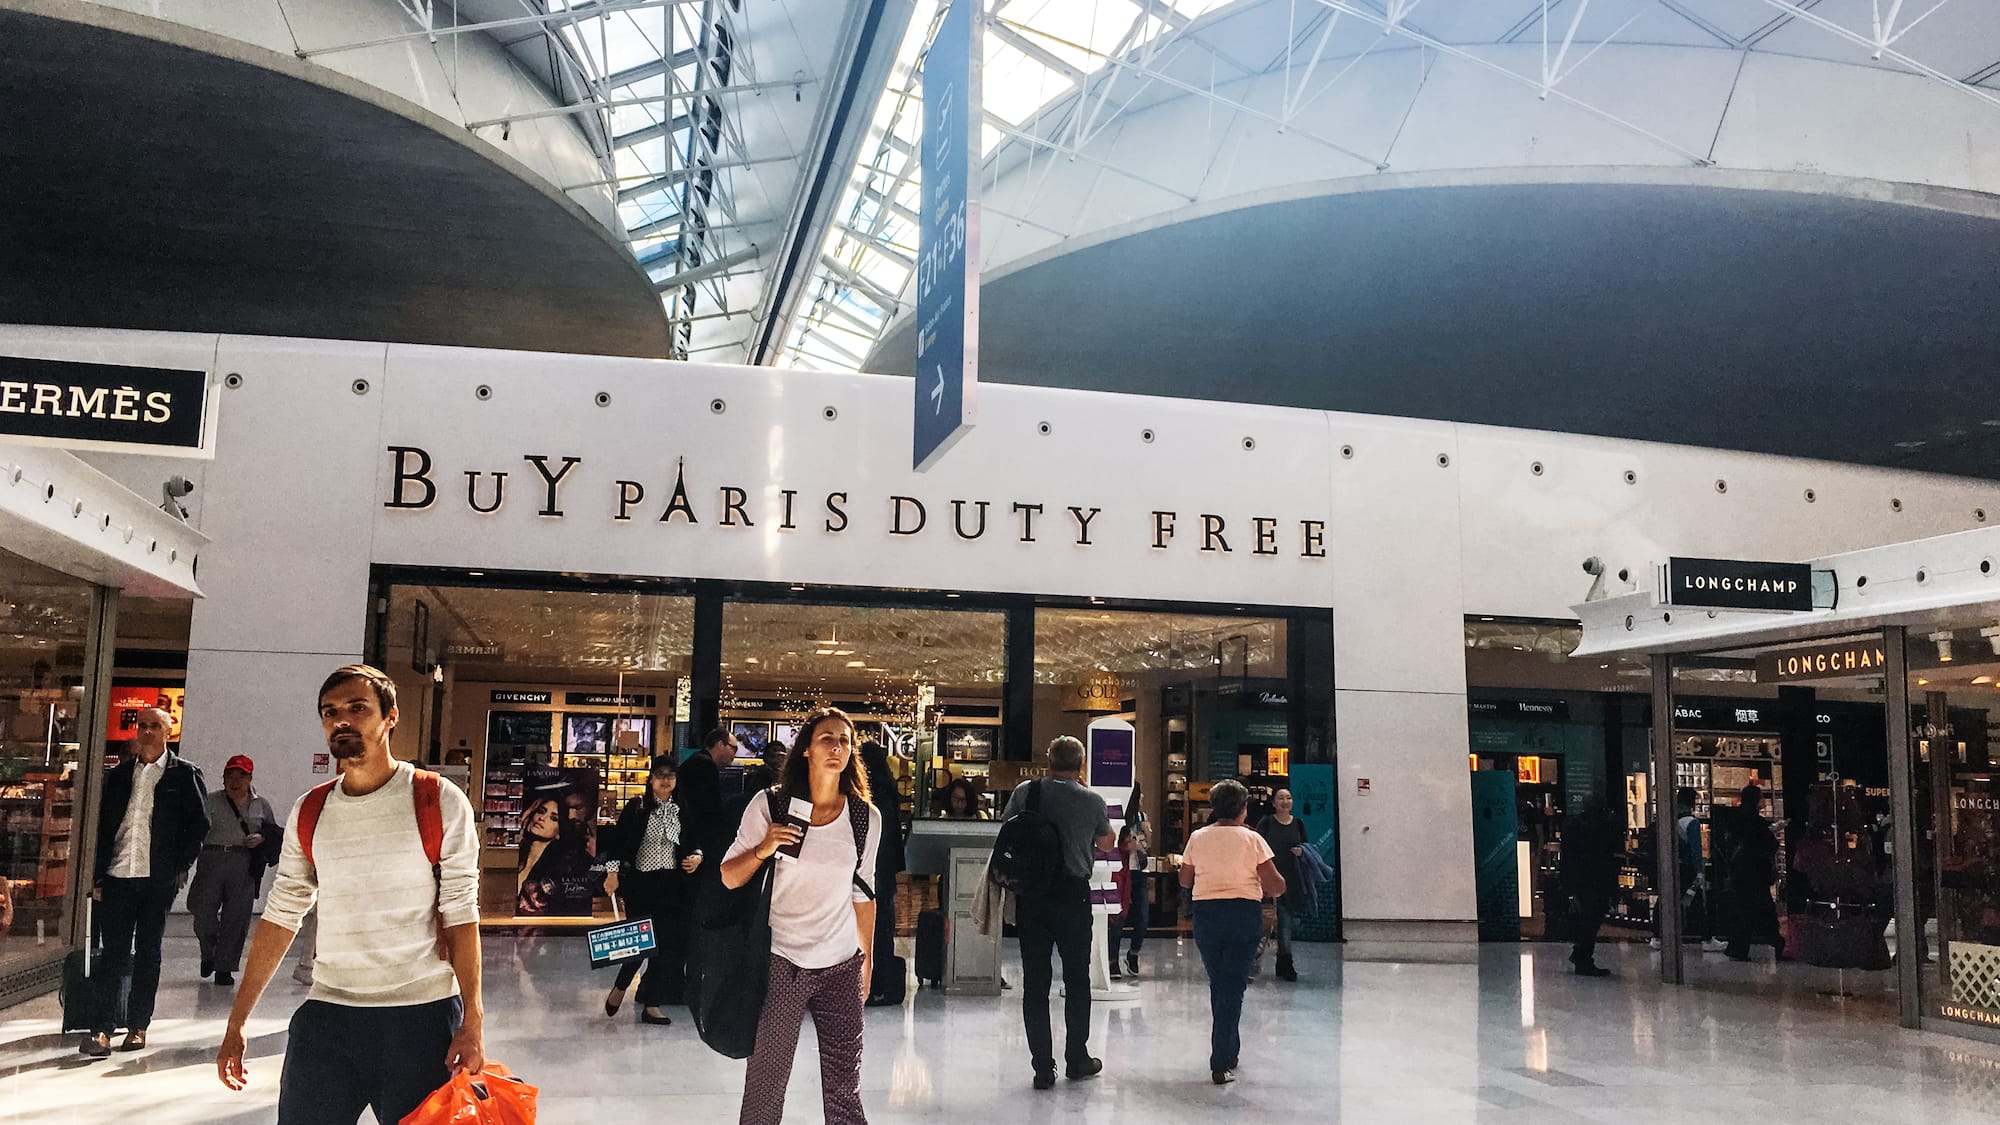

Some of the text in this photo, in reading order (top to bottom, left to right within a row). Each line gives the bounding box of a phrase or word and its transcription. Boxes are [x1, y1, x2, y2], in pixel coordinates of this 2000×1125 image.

[919, 199, 965, 305] F21 F36
[0, 380, 172, 424] ERMÈS
[384, 445, 1327, 558] BUY PARIS DUTY FREE
[1685, 575, 1798, 594] LONGCHAMP
[495, 693, 547, 702] GIVENCHY
[1077, 683, 1119, 699] GOLD
[1518, 702, 1553, 713] Hennessy
[1735, 708, 1760, 723] 烟草
[1941, 1005, 2000, 1024] LONGCHAM
